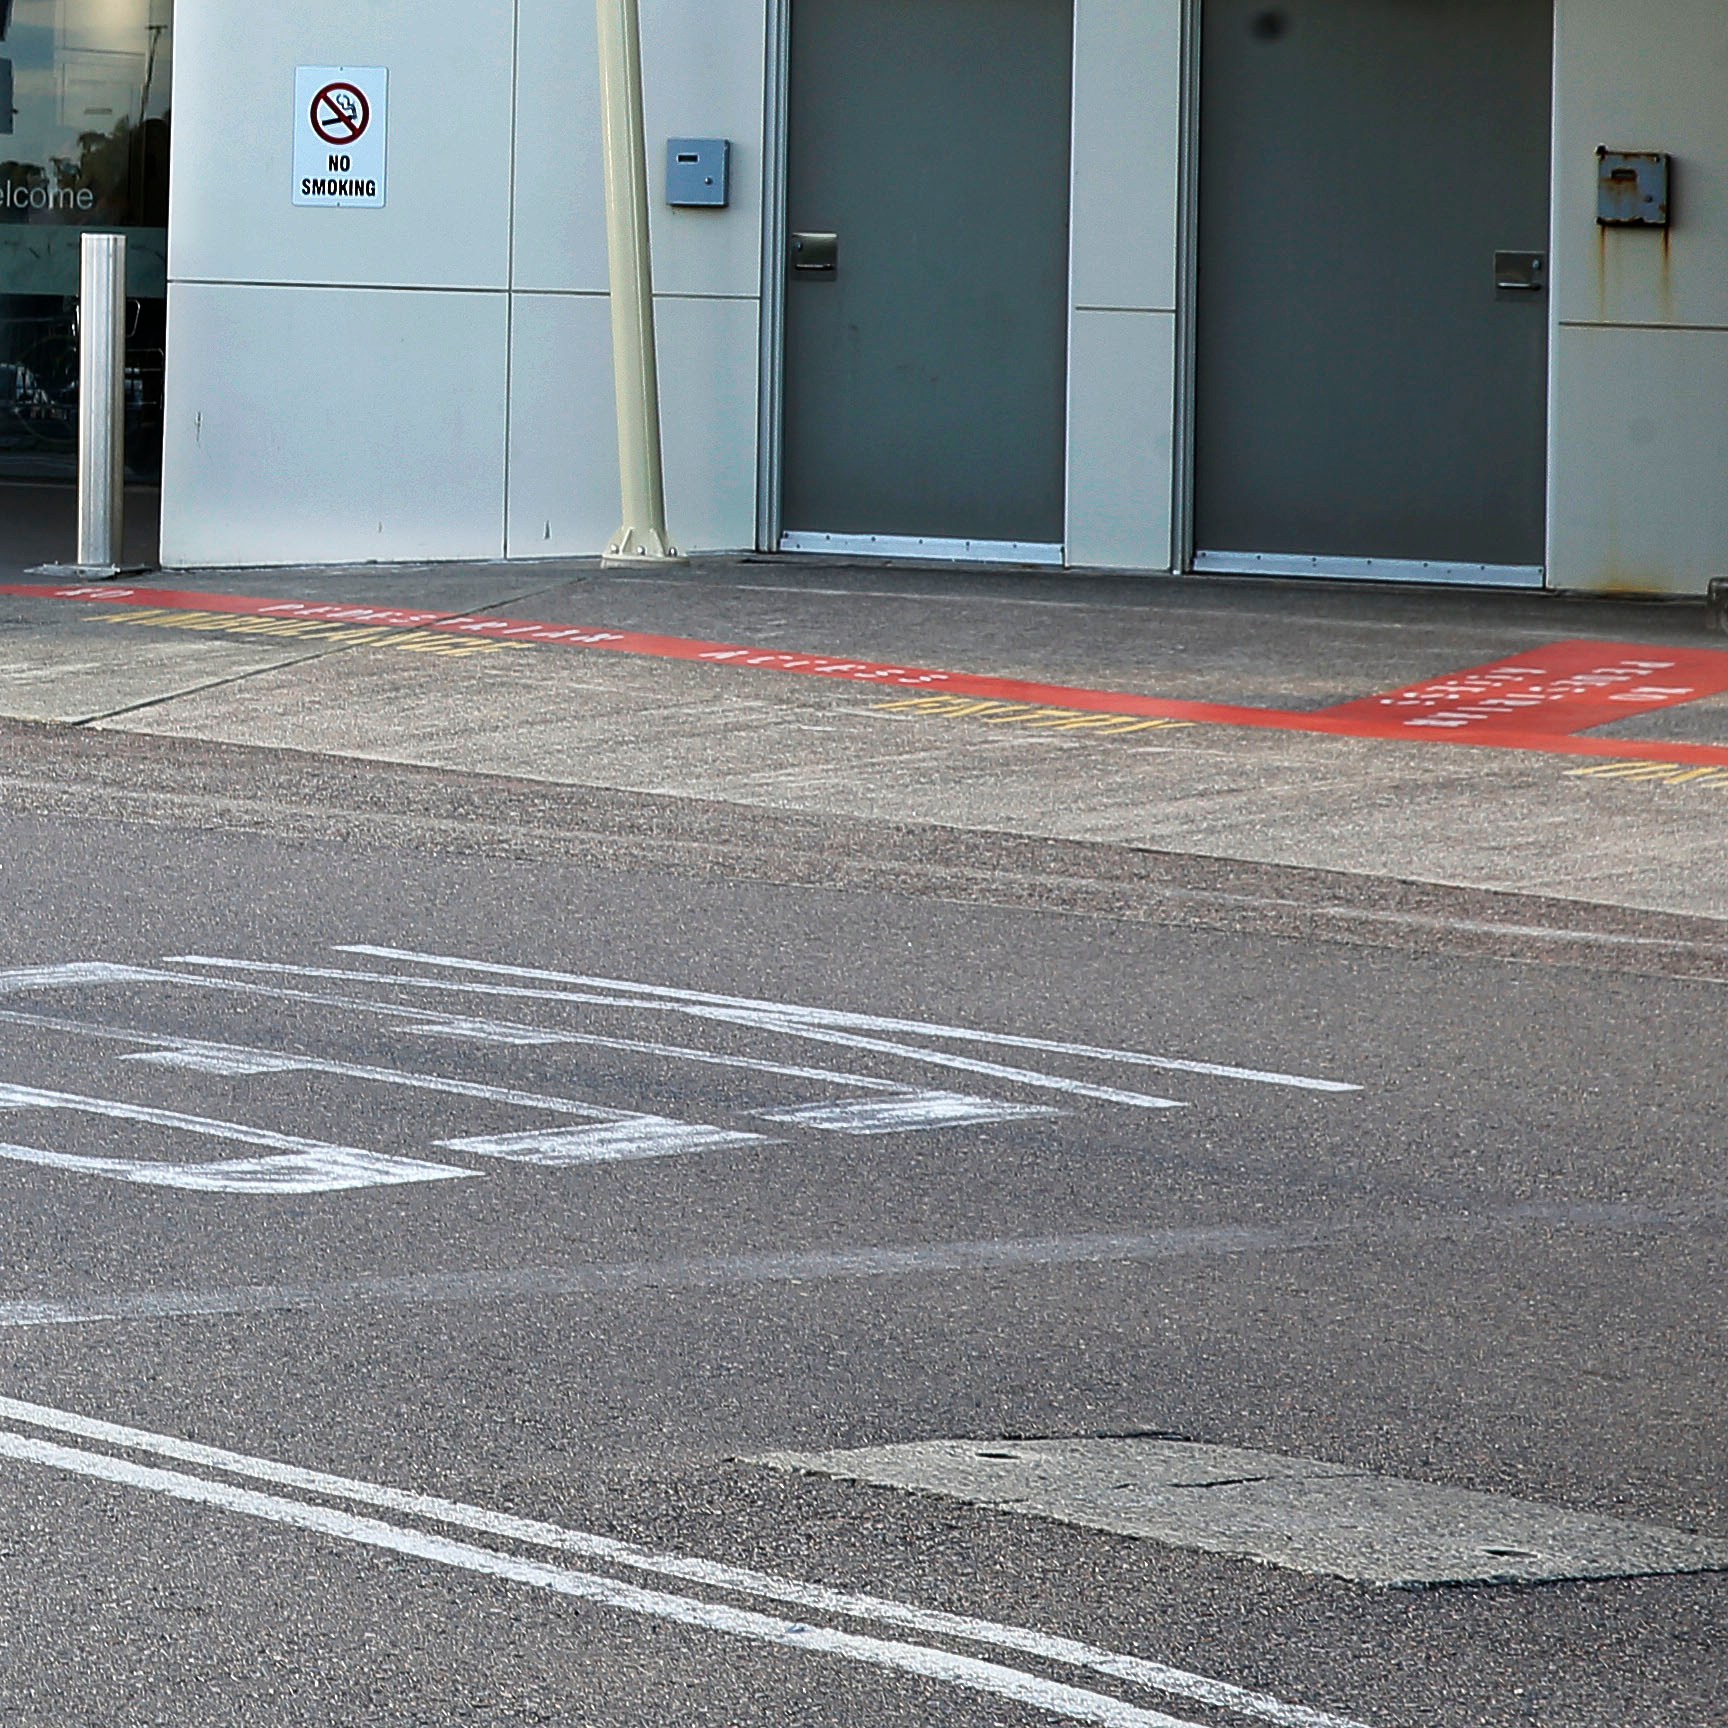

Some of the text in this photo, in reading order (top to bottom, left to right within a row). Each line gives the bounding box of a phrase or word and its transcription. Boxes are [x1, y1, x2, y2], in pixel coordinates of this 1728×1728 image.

[328, 154, 351, 172] NO
[301, 178, 376, 197] SMOKING
[257, 603, 625, 644] PEDESTRIAN
[698, 649, 949, 684] ACCESS
[1379, 666, 1548, 706] ACCESS
[1402, 660, 1677, 728] PEDESTRIAN
